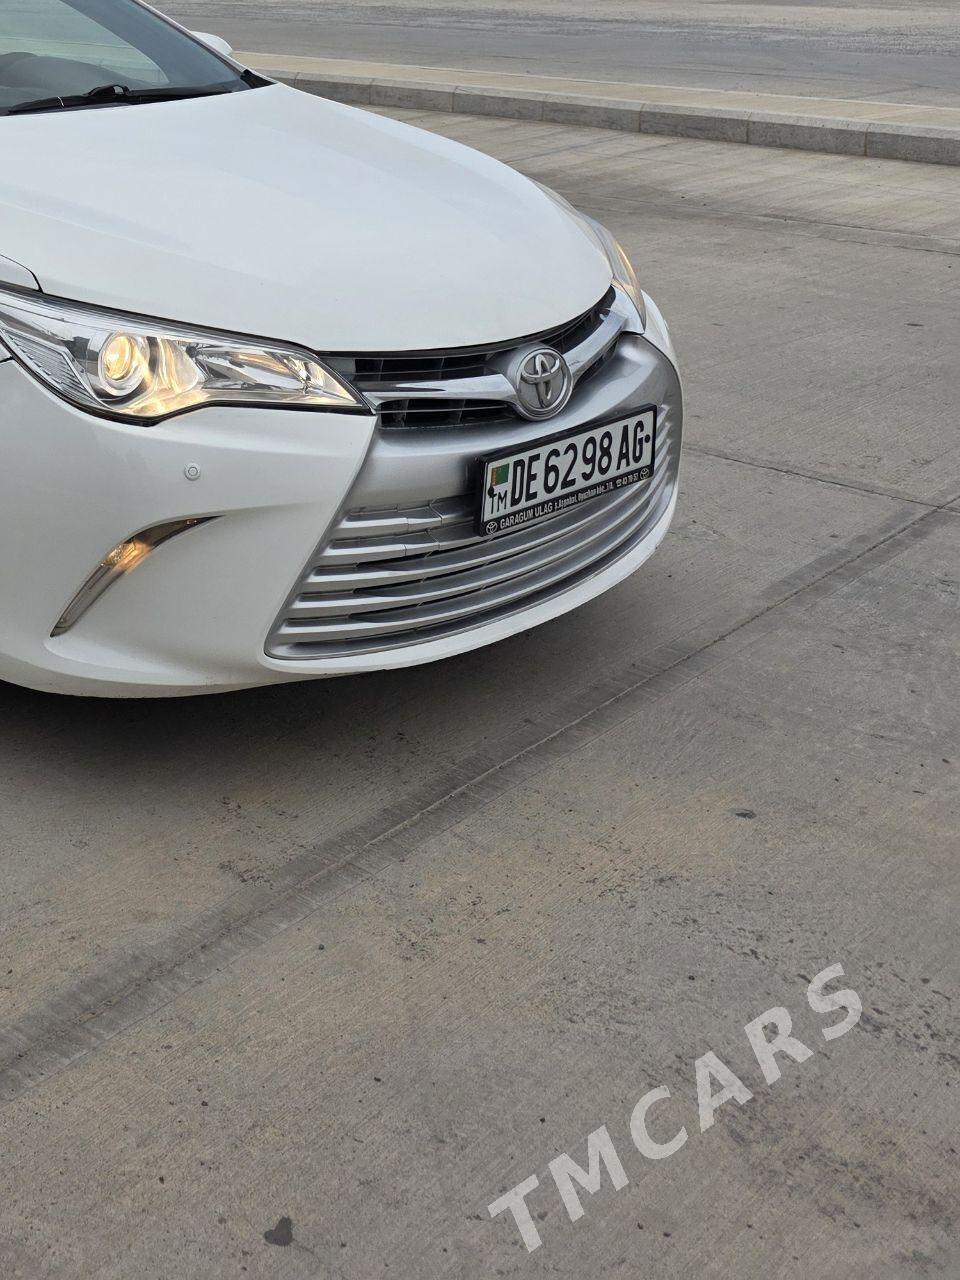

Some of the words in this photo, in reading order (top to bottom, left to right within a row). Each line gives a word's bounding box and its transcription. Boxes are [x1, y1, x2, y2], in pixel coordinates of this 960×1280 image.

[489, 490, 507, 514] TM
[500, 506, 534, 529] GARAGUM
[534, 500, 553, 517] ULAG
